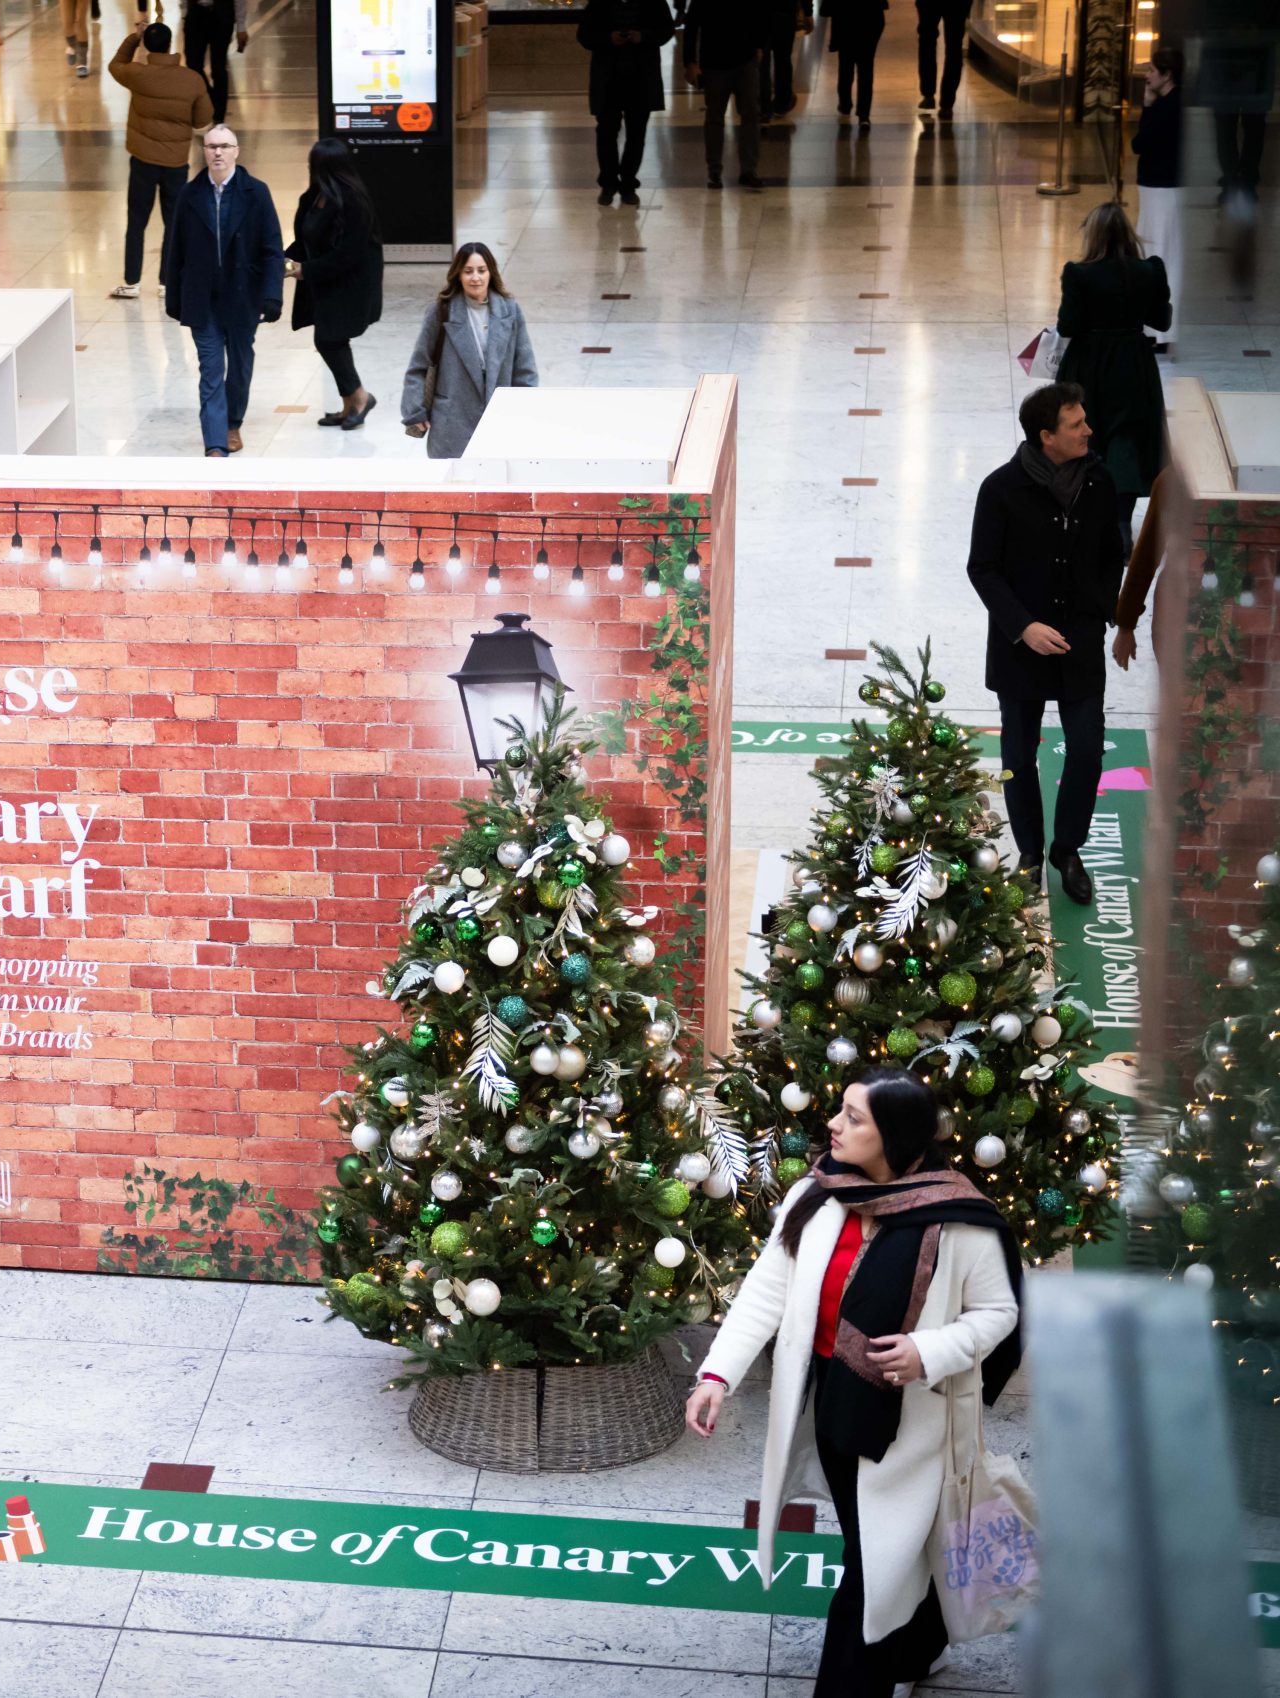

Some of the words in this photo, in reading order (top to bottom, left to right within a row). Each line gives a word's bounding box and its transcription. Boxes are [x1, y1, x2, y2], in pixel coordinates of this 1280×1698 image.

[753, 728, 807, 746] of
[1084, 870, 1140, 940] Canary
[1083, 936, 1144, 960] of
[20, 994, 88, 1018] your
[1092, 962, 1141, 1028] House
[77, 1505, 318, 1554] House
[330, 1524, 419, 1565] of
[412, 1528, 696, 1586] Canary
[975, 1542, 993, 1570] OF
